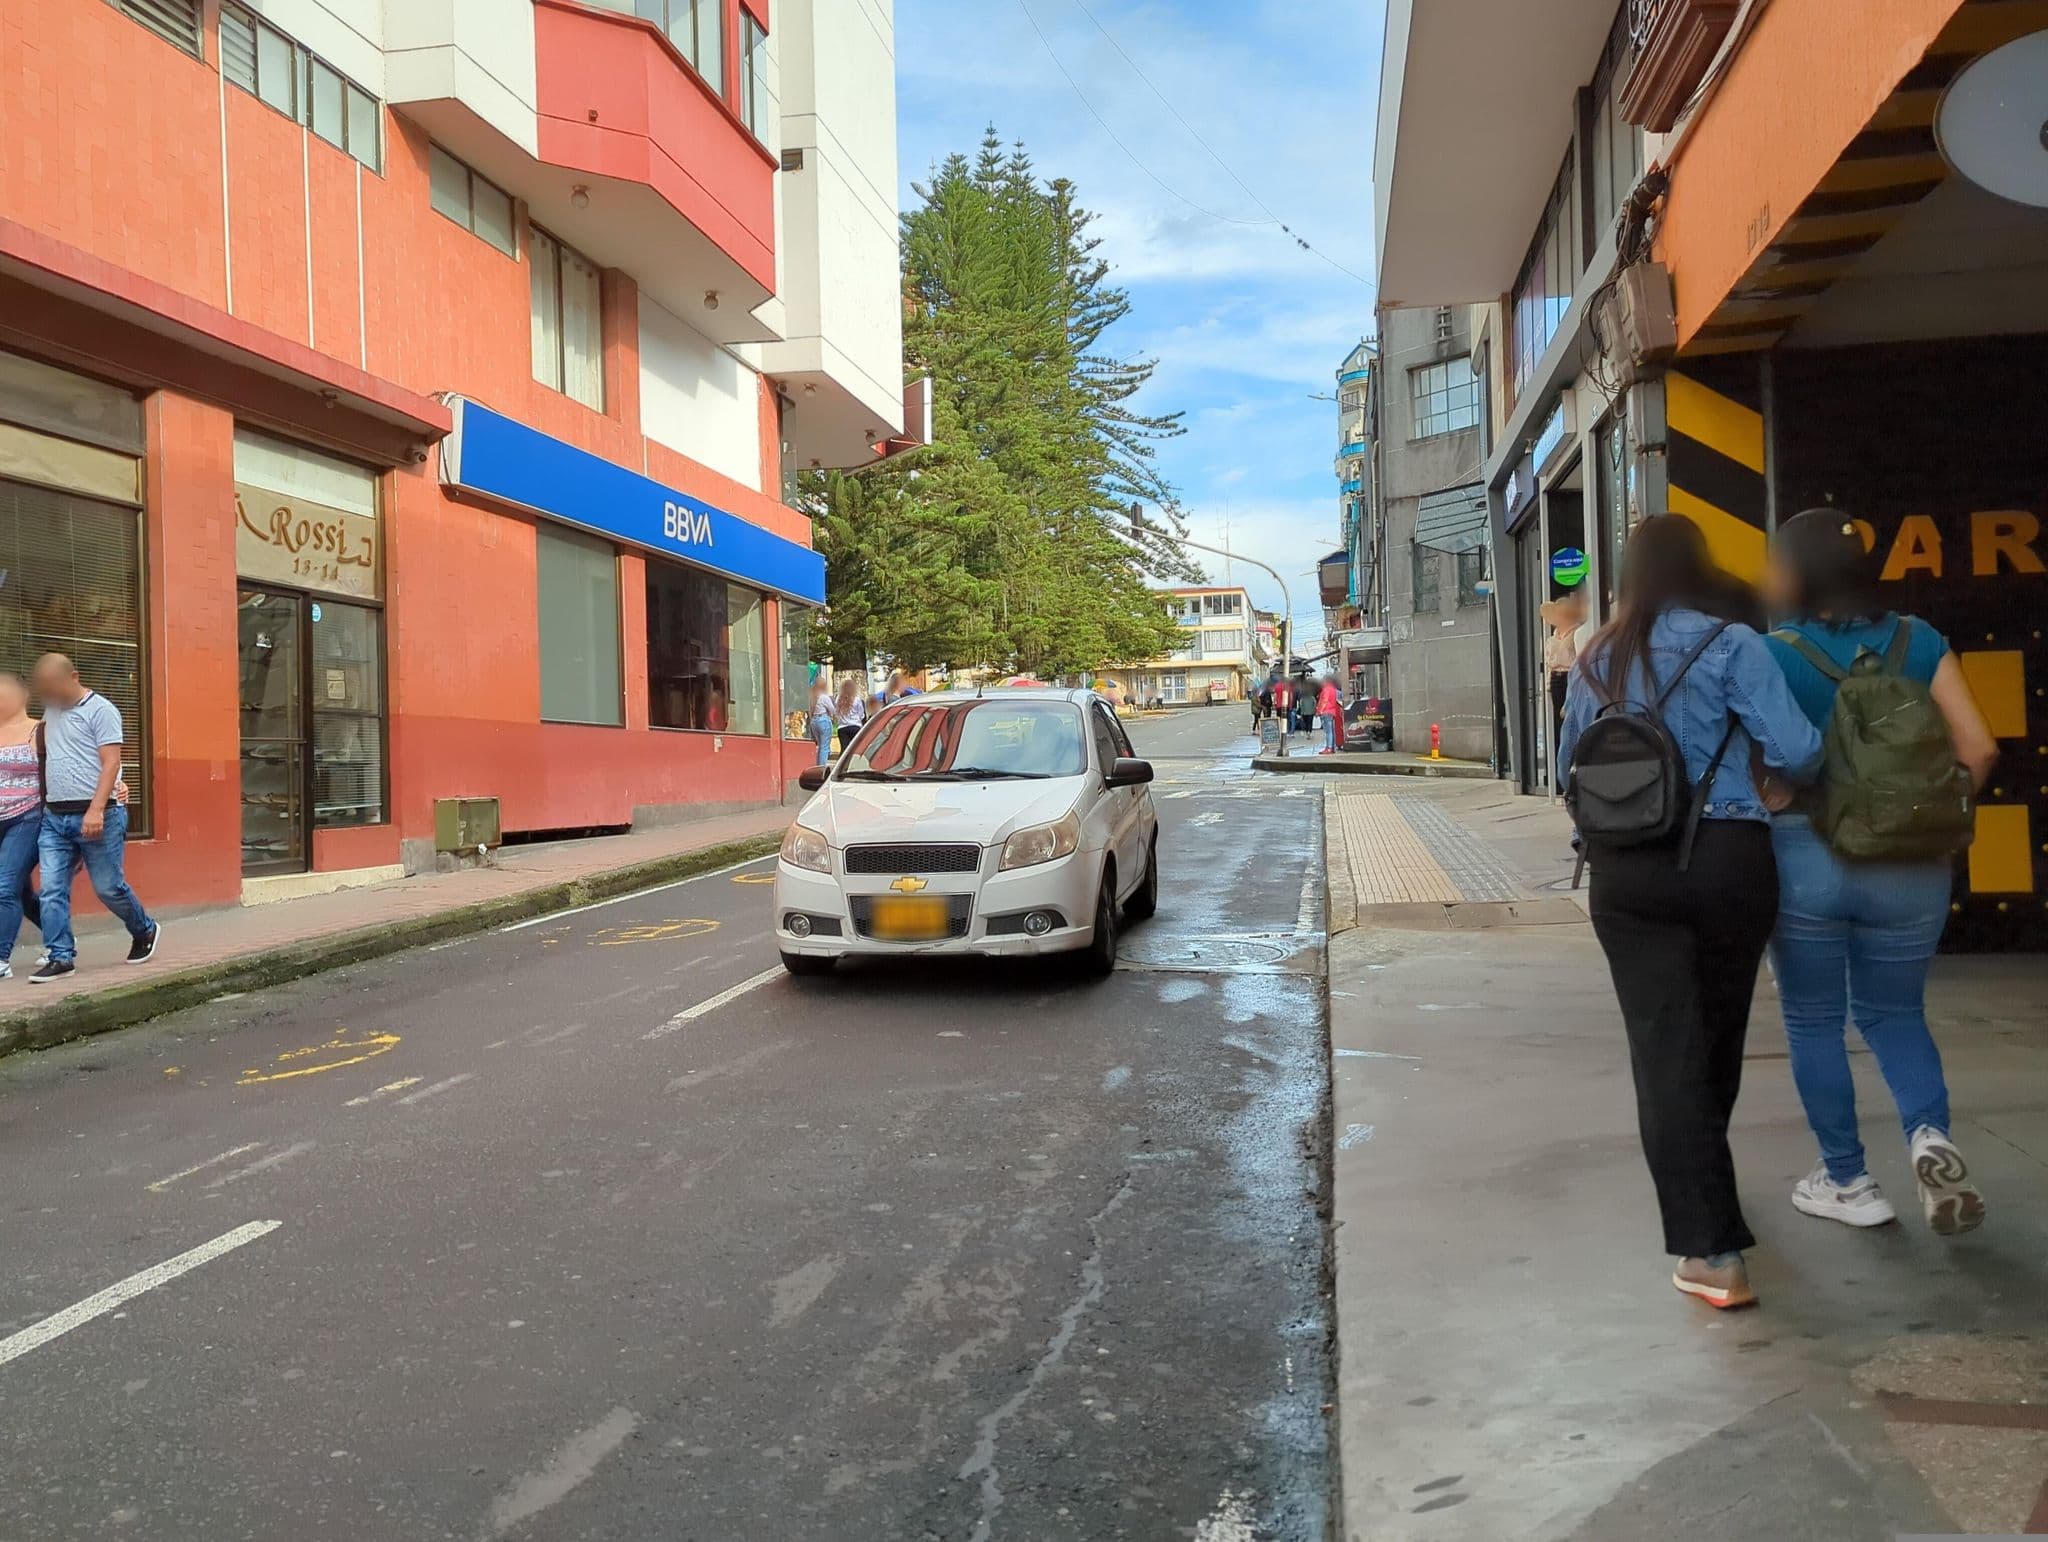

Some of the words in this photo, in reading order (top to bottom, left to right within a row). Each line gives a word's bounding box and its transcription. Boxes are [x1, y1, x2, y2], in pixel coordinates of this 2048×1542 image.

[269, 506, 347, 554] Rossi
[664, 500, 713, 547] BBVA
[1850, 510, 2047, 581] AR
